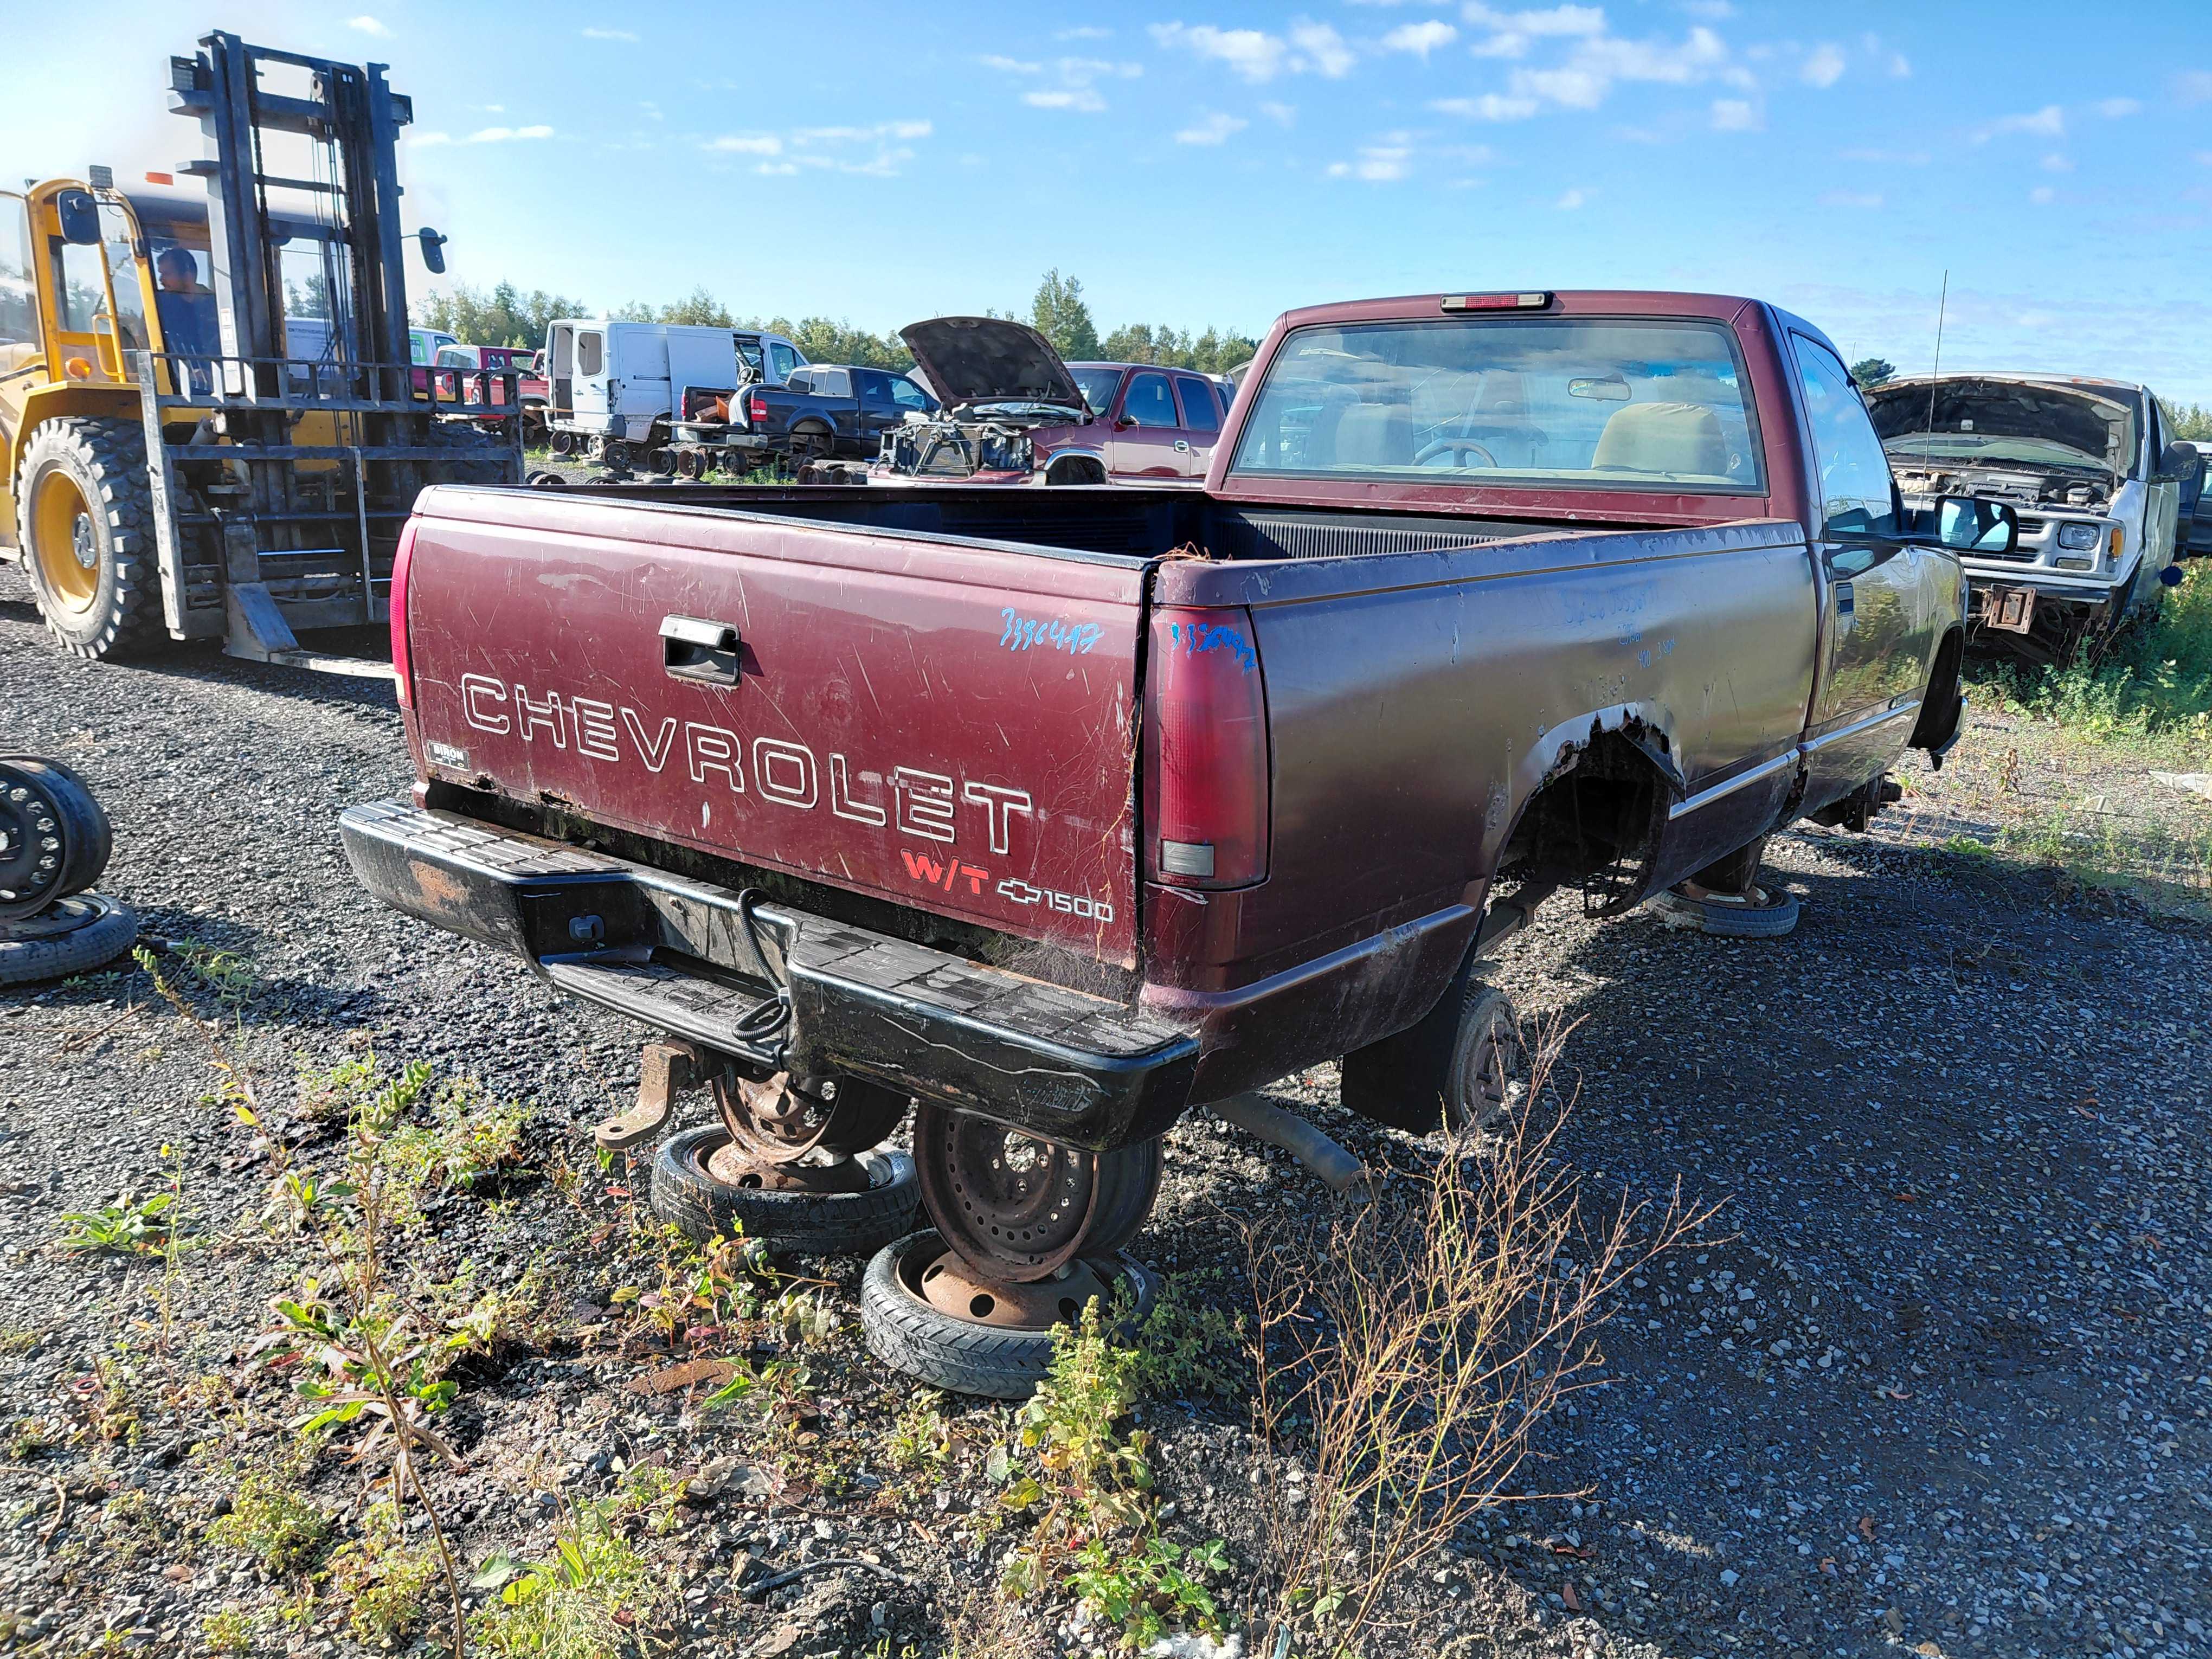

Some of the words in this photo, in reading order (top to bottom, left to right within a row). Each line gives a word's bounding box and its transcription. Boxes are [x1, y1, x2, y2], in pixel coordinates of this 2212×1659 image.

[433, 744, 464, 761] BIRON
[461, 672, 1032, 856] CHEVROLET
[901, 850, 991, 895] W/T
[1044, 889, 1114, 923] 1500
